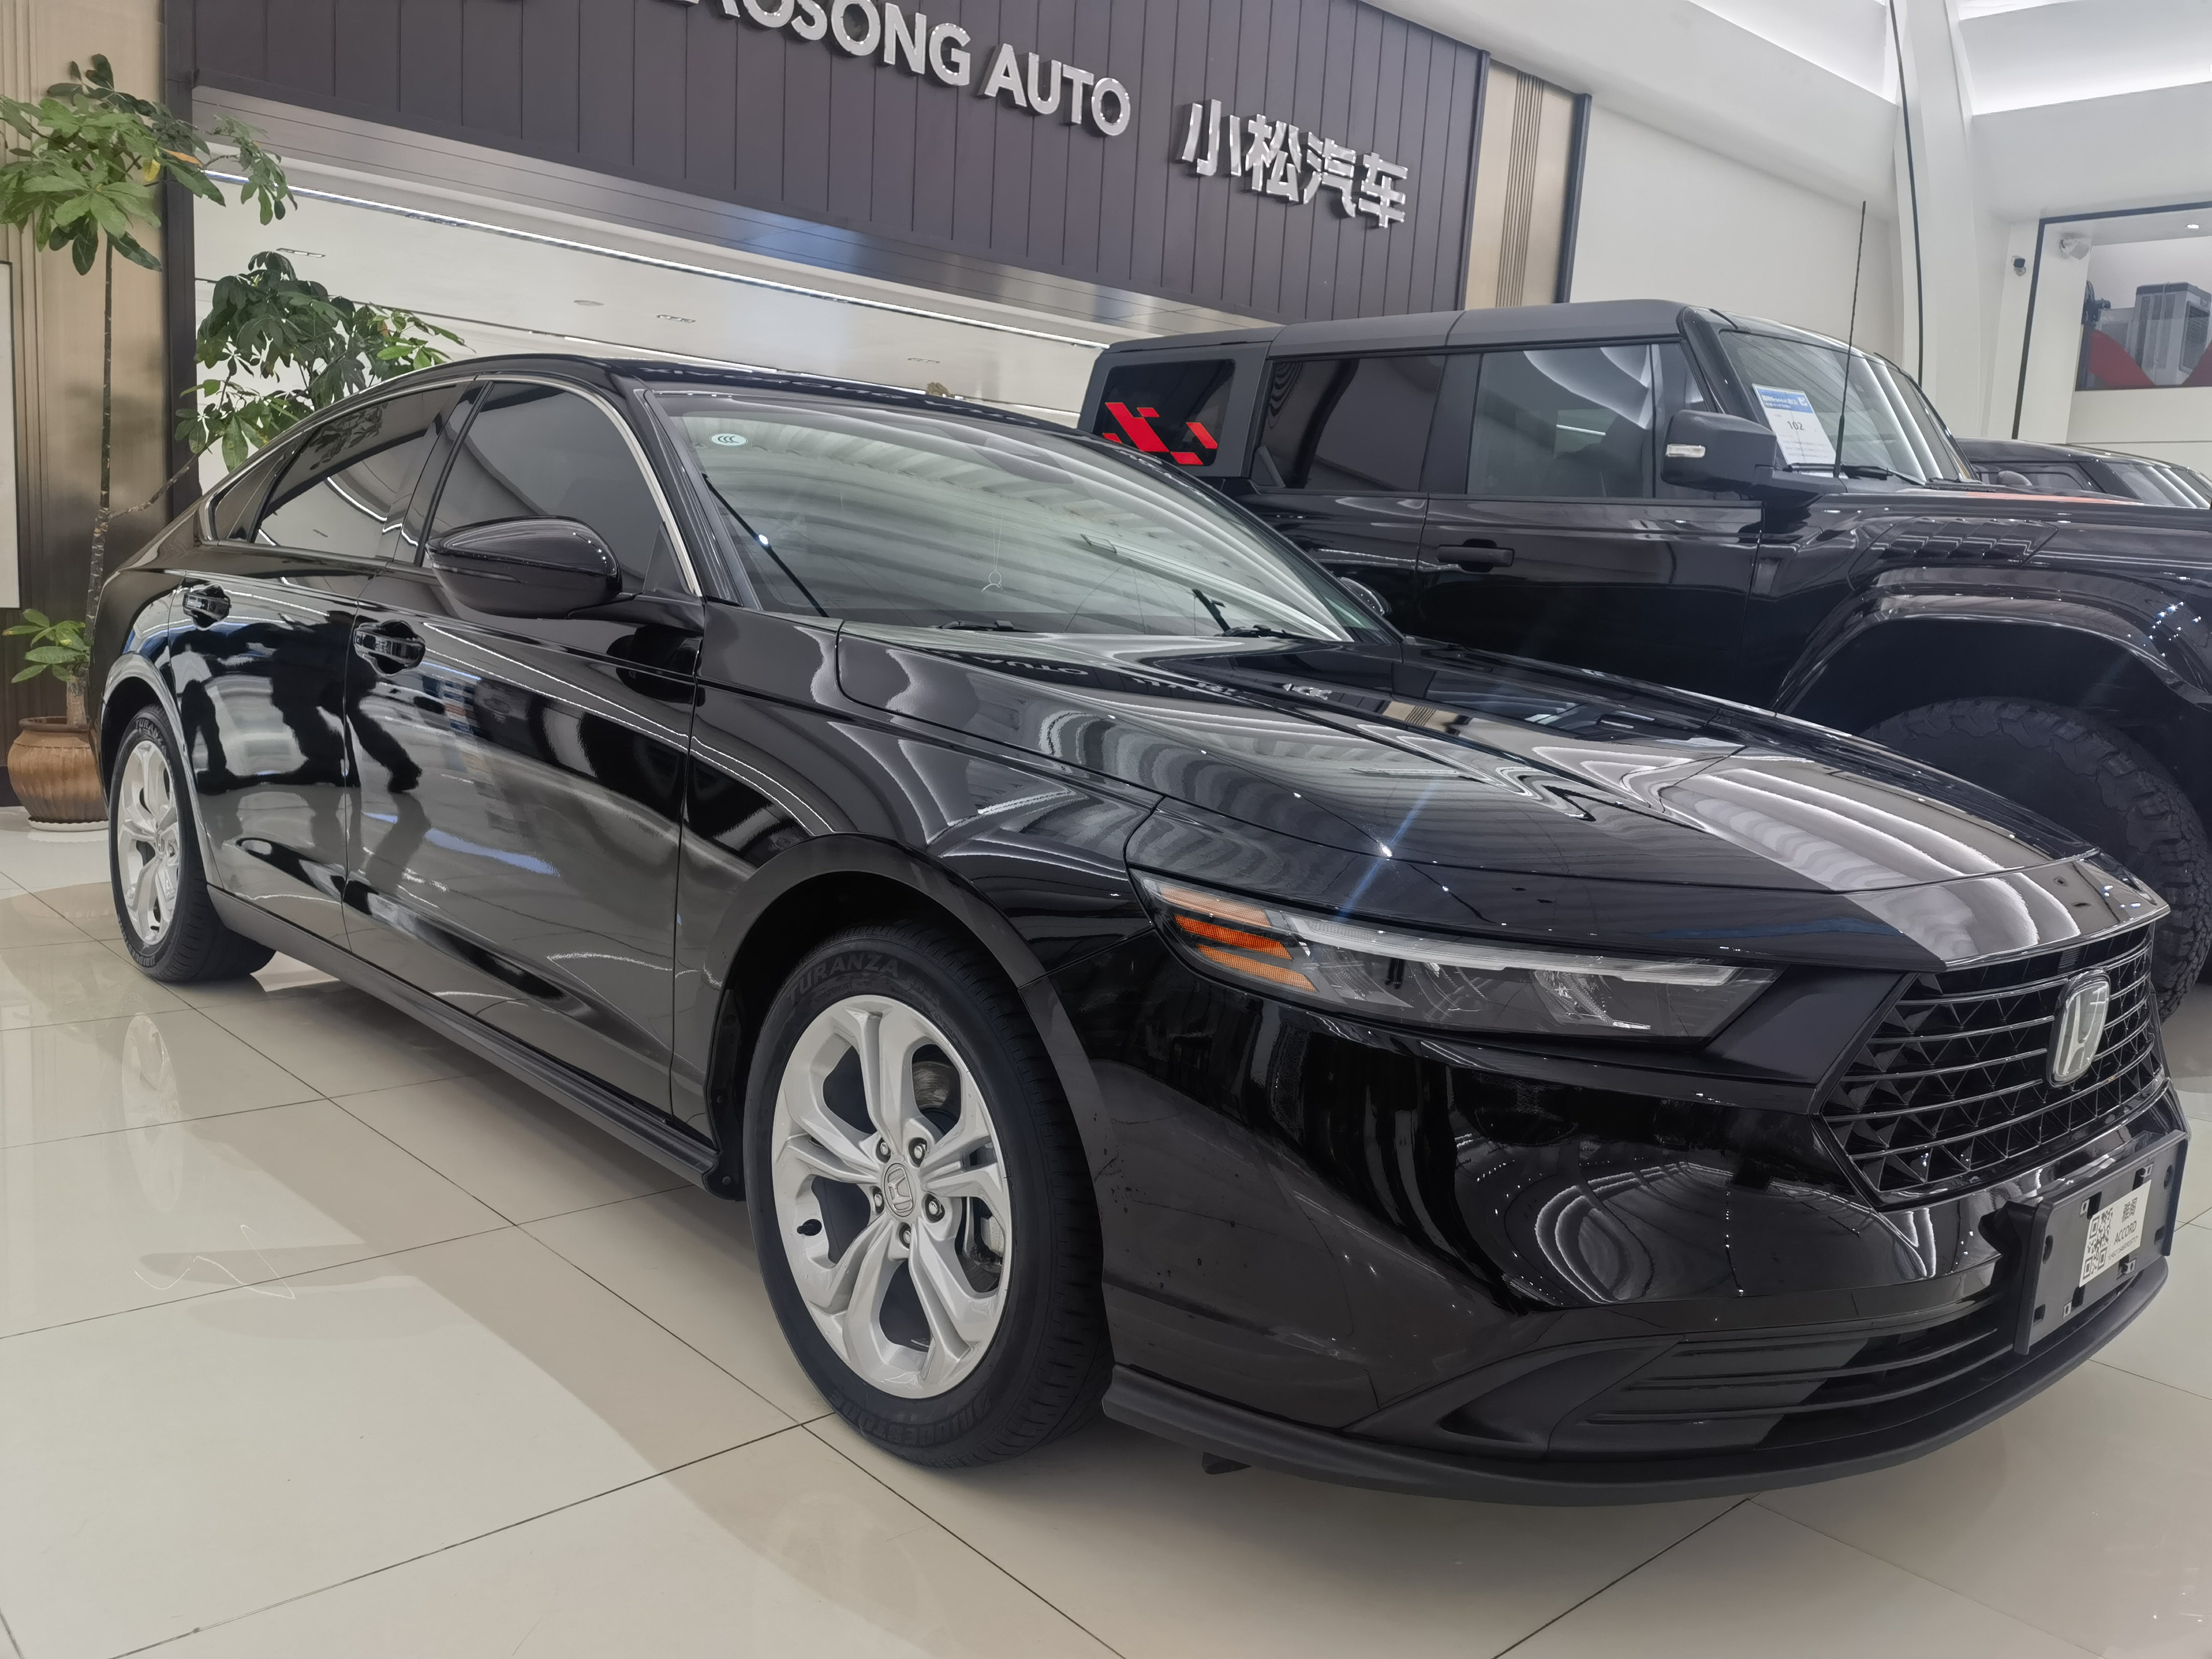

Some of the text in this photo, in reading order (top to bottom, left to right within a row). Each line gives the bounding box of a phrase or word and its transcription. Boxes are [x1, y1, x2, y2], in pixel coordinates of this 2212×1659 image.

[979, 43, 1131, 136] AUTO
[1177, 99, 1408, 227] 小松汽车
[1787, 421, 1805, 430] 102
[787, 953, 899, 1005] TURANZA
[2114, 1220, 2137, 1245] ACCORD
